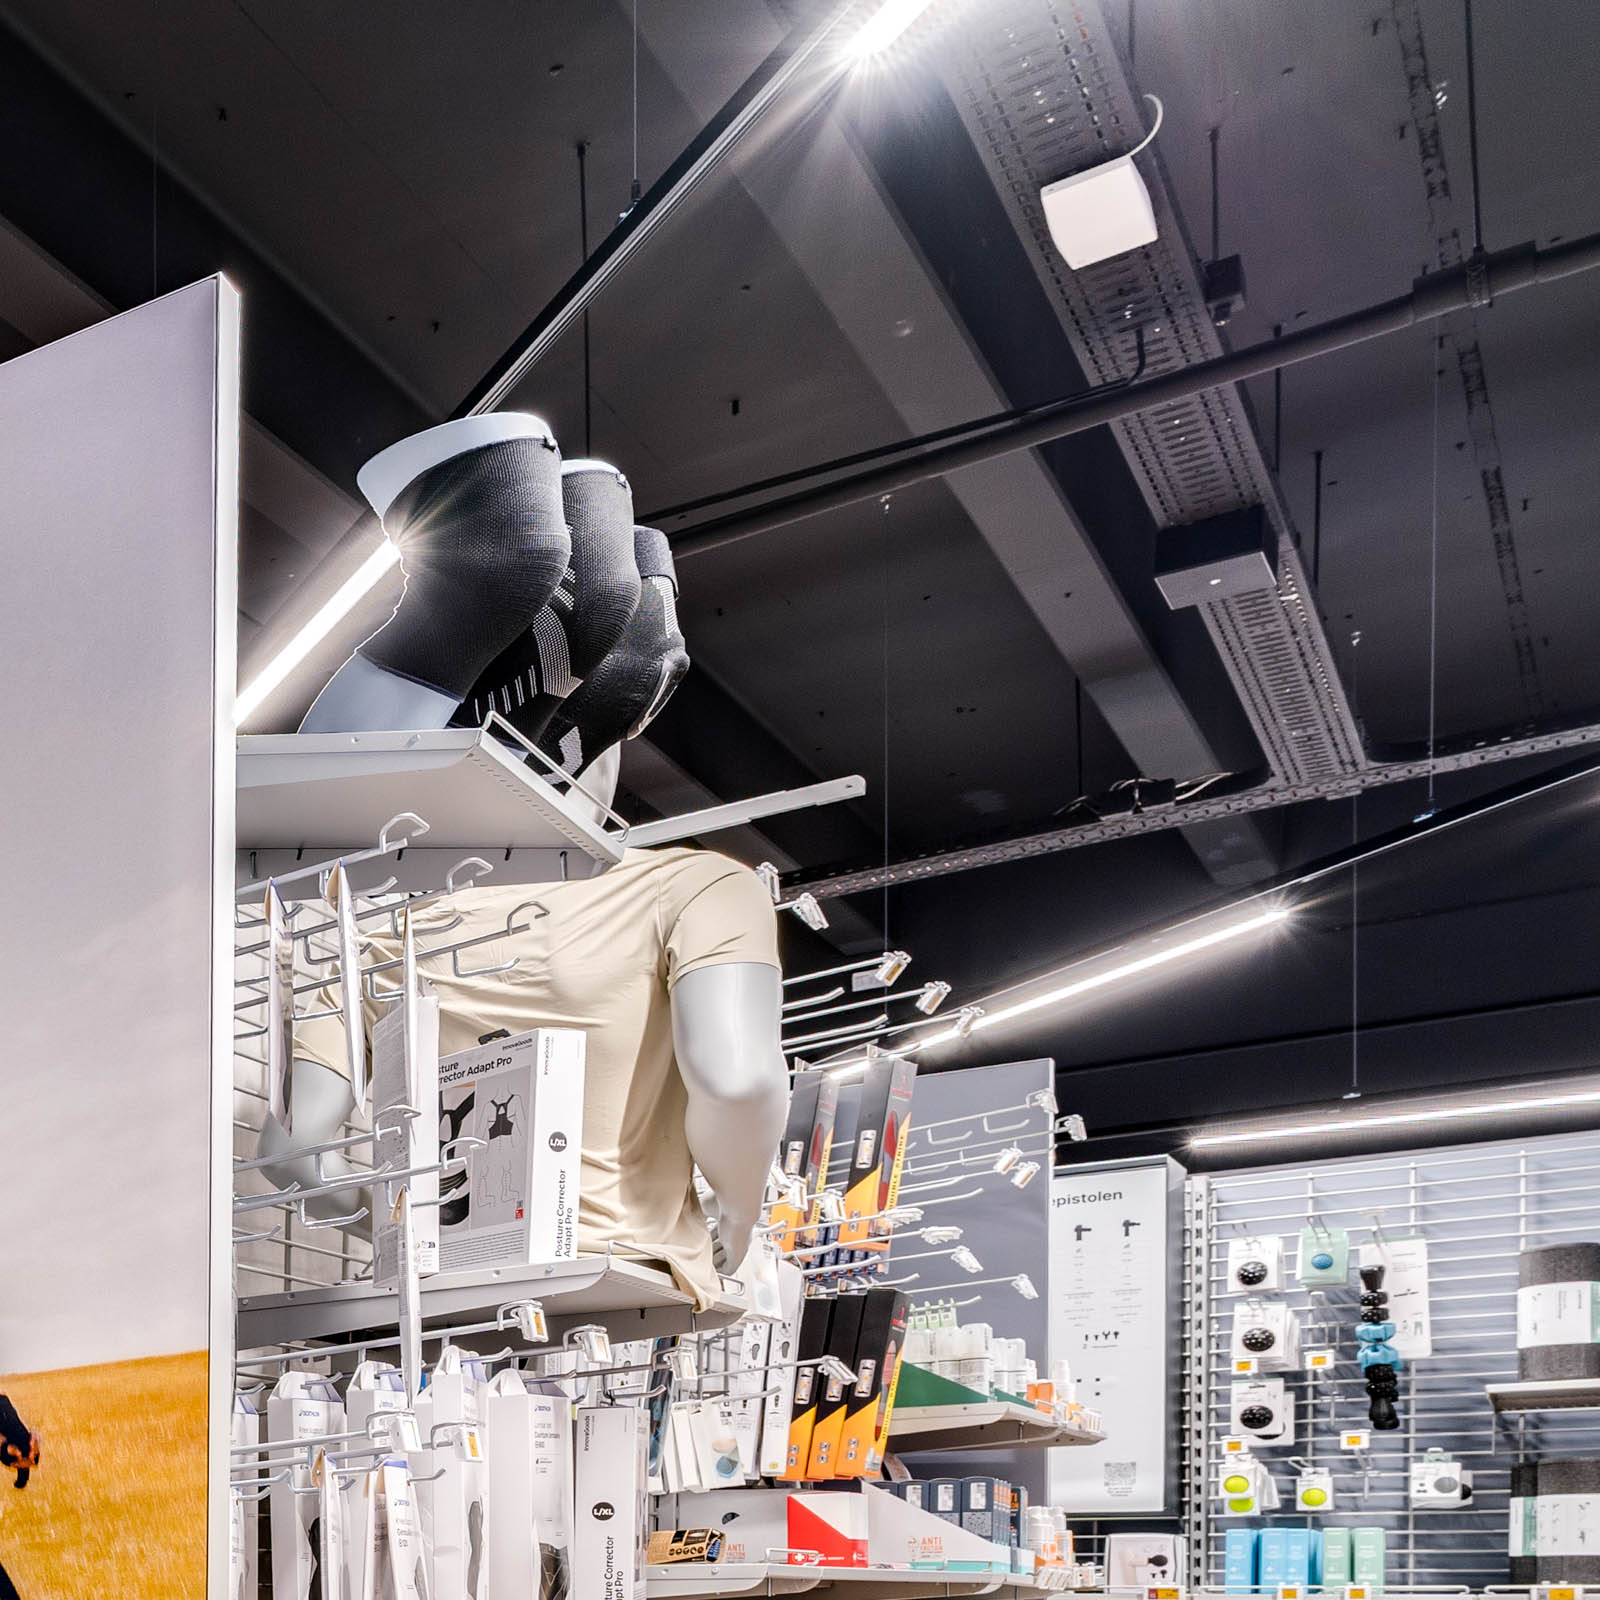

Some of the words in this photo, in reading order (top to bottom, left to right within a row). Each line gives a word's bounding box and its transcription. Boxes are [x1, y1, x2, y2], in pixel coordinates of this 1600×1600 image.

[439, 1061, 459, 1074] ture
[439, 1068, 466, 1084] rector
[467, 1059, 495, 1076] Adapt
[497, 1055, 513, 1067] Pro
[557, 1168, 567, 1218] Corrector
[564, 1206, 573, 1225] Pro
[554, 1219, 564, 1258] Posture
[563, 1228, 573, 1258] Adapt
[604, 1535, 614, 1575] Corrector
[614, 1569, 624, 1587] Pro
